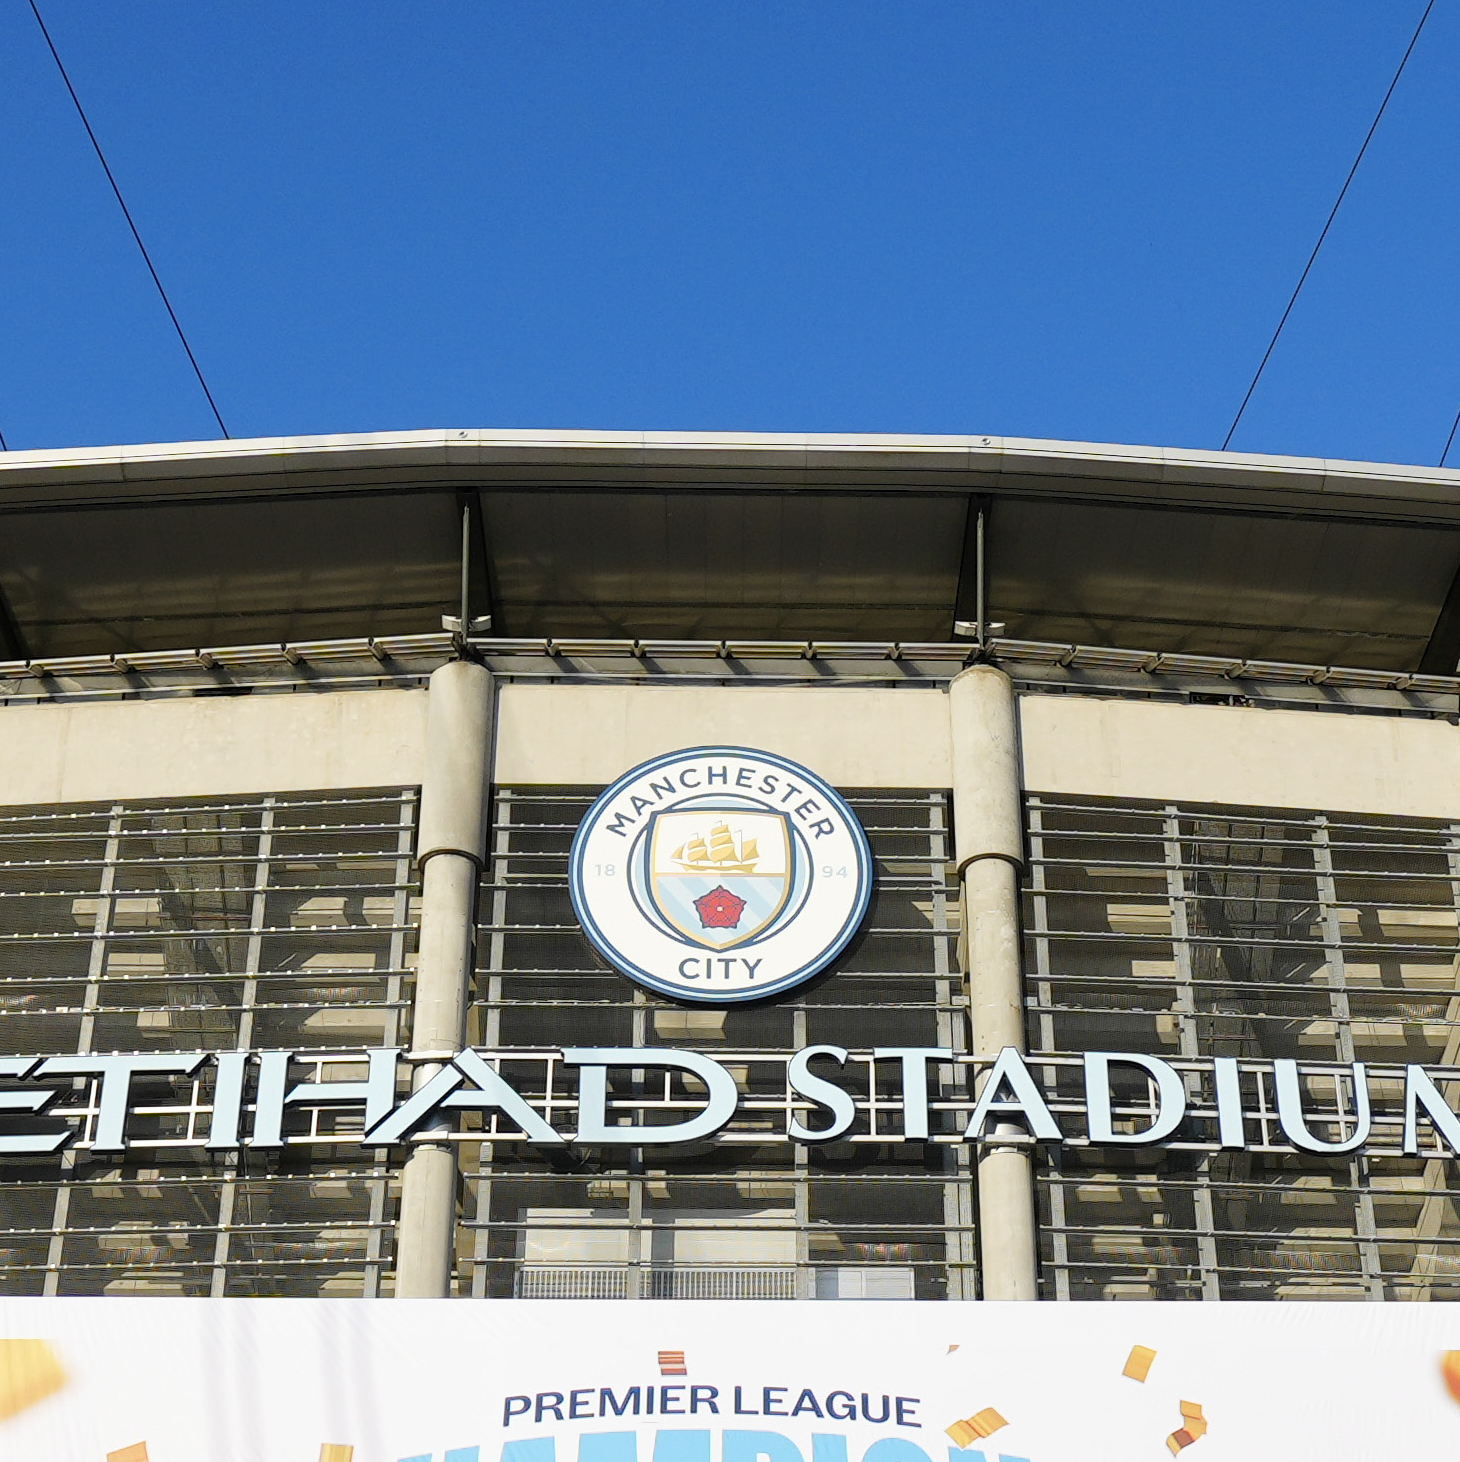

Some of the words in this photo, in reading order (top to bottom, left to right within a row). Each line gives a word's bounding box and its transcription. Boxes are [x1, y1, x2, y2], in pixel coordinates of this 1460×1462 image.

[605, 765, 835, 840] MANCHESTER
[594, 863, 616, 877] 18
[821, 865, 849, 878] 94
[678, 957, 763, 980] CITY
[502, 1384, 720, 1428] PREMIER
[734, 1385, 923, 1429] LEAGUE
